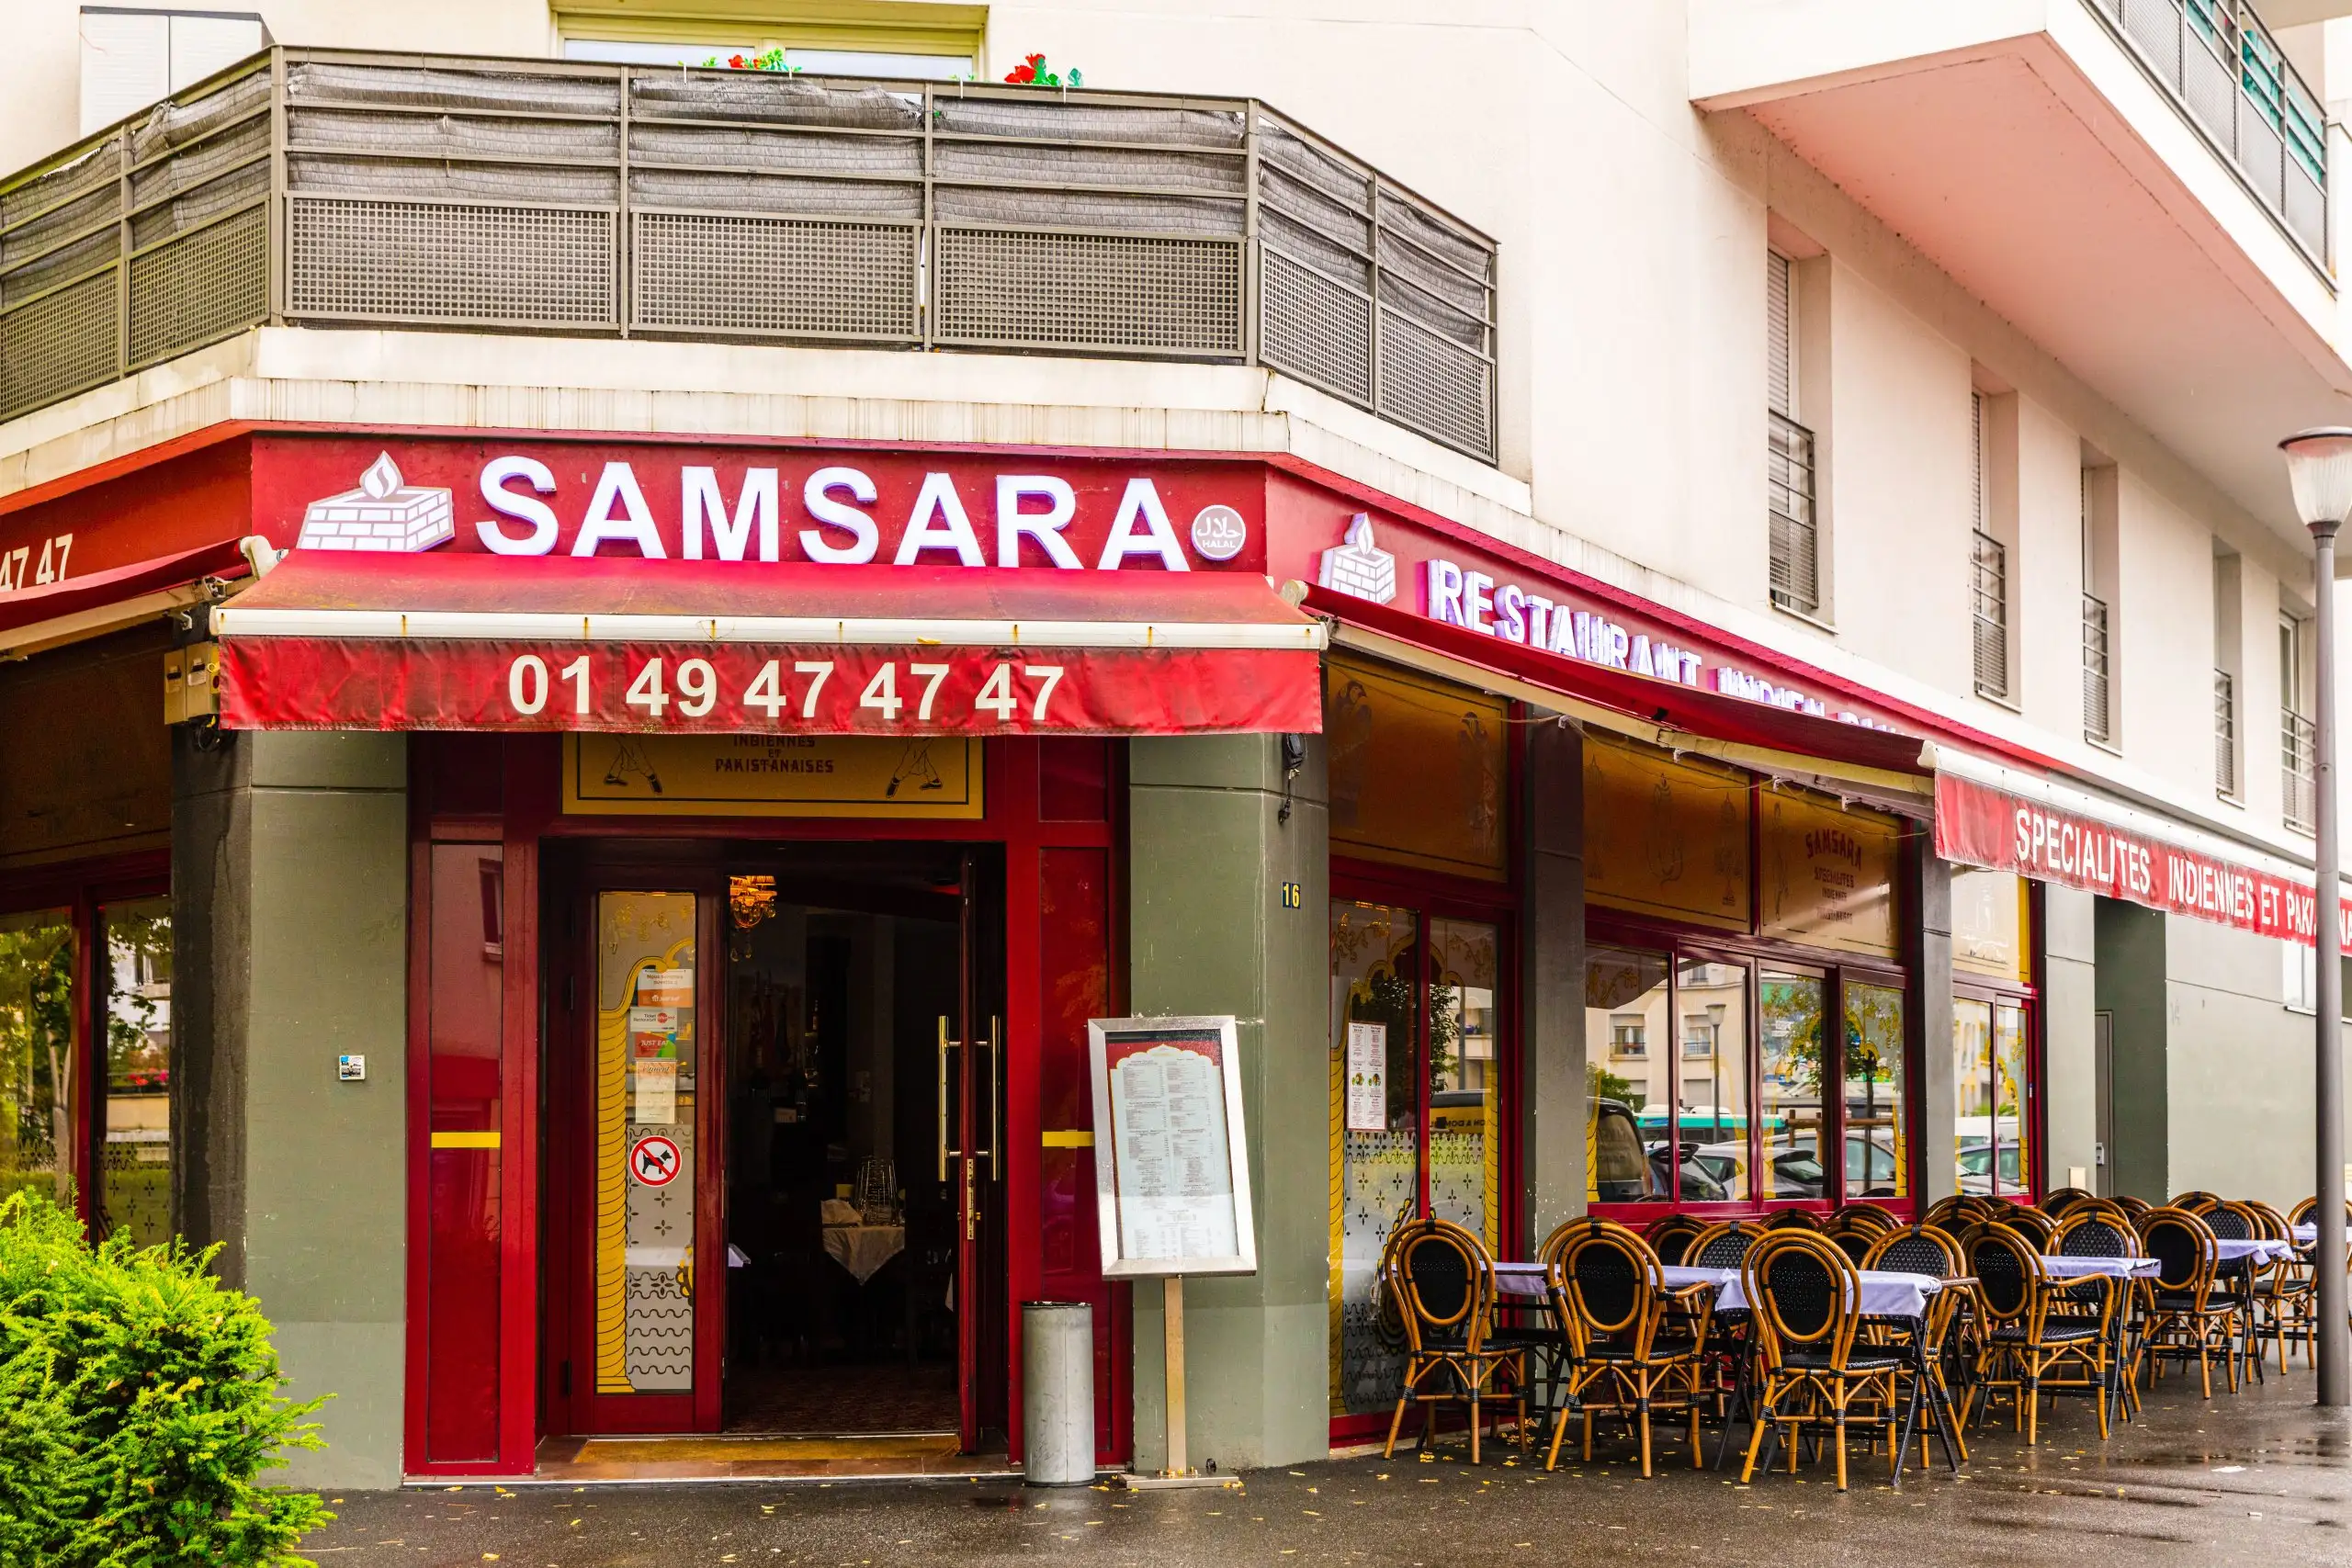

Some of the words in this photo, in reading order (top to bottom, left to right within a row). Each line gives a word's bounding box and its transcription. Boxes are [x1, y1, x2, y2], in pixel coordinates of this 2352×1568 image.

[476, 456, 1191, 572] SAMSARA
[1197, 516, 1241, 538] حلال
[1202, 539, 1237, 548] HALAL
[0, 546, 29, 592] 47
[36, 533, 73, 585] 47
[1427, 558, 1702, 687] RESTAURANT
[508, 654, 590, 716] 01
[626, 658, 718, 717] 49
[743, 660, 834, 718] 47
[860, 661, 950, 720] 47
[975, 663, 1065, 721] 47
[733, 734, 816, 748] INDIENNES
[768, 749, 782, 758] ET
[715, 758, 834, 773] PAKISTANAISES
[1805, 828, 1862, 871] SAMSARA
[2016, 808, 2151, 895] SPECIALITES
[2168, 855, 2255, 919] INDIENNES
[2260, 883, 2280, 926] ET
[1283, 883, 1300, 908] 16
